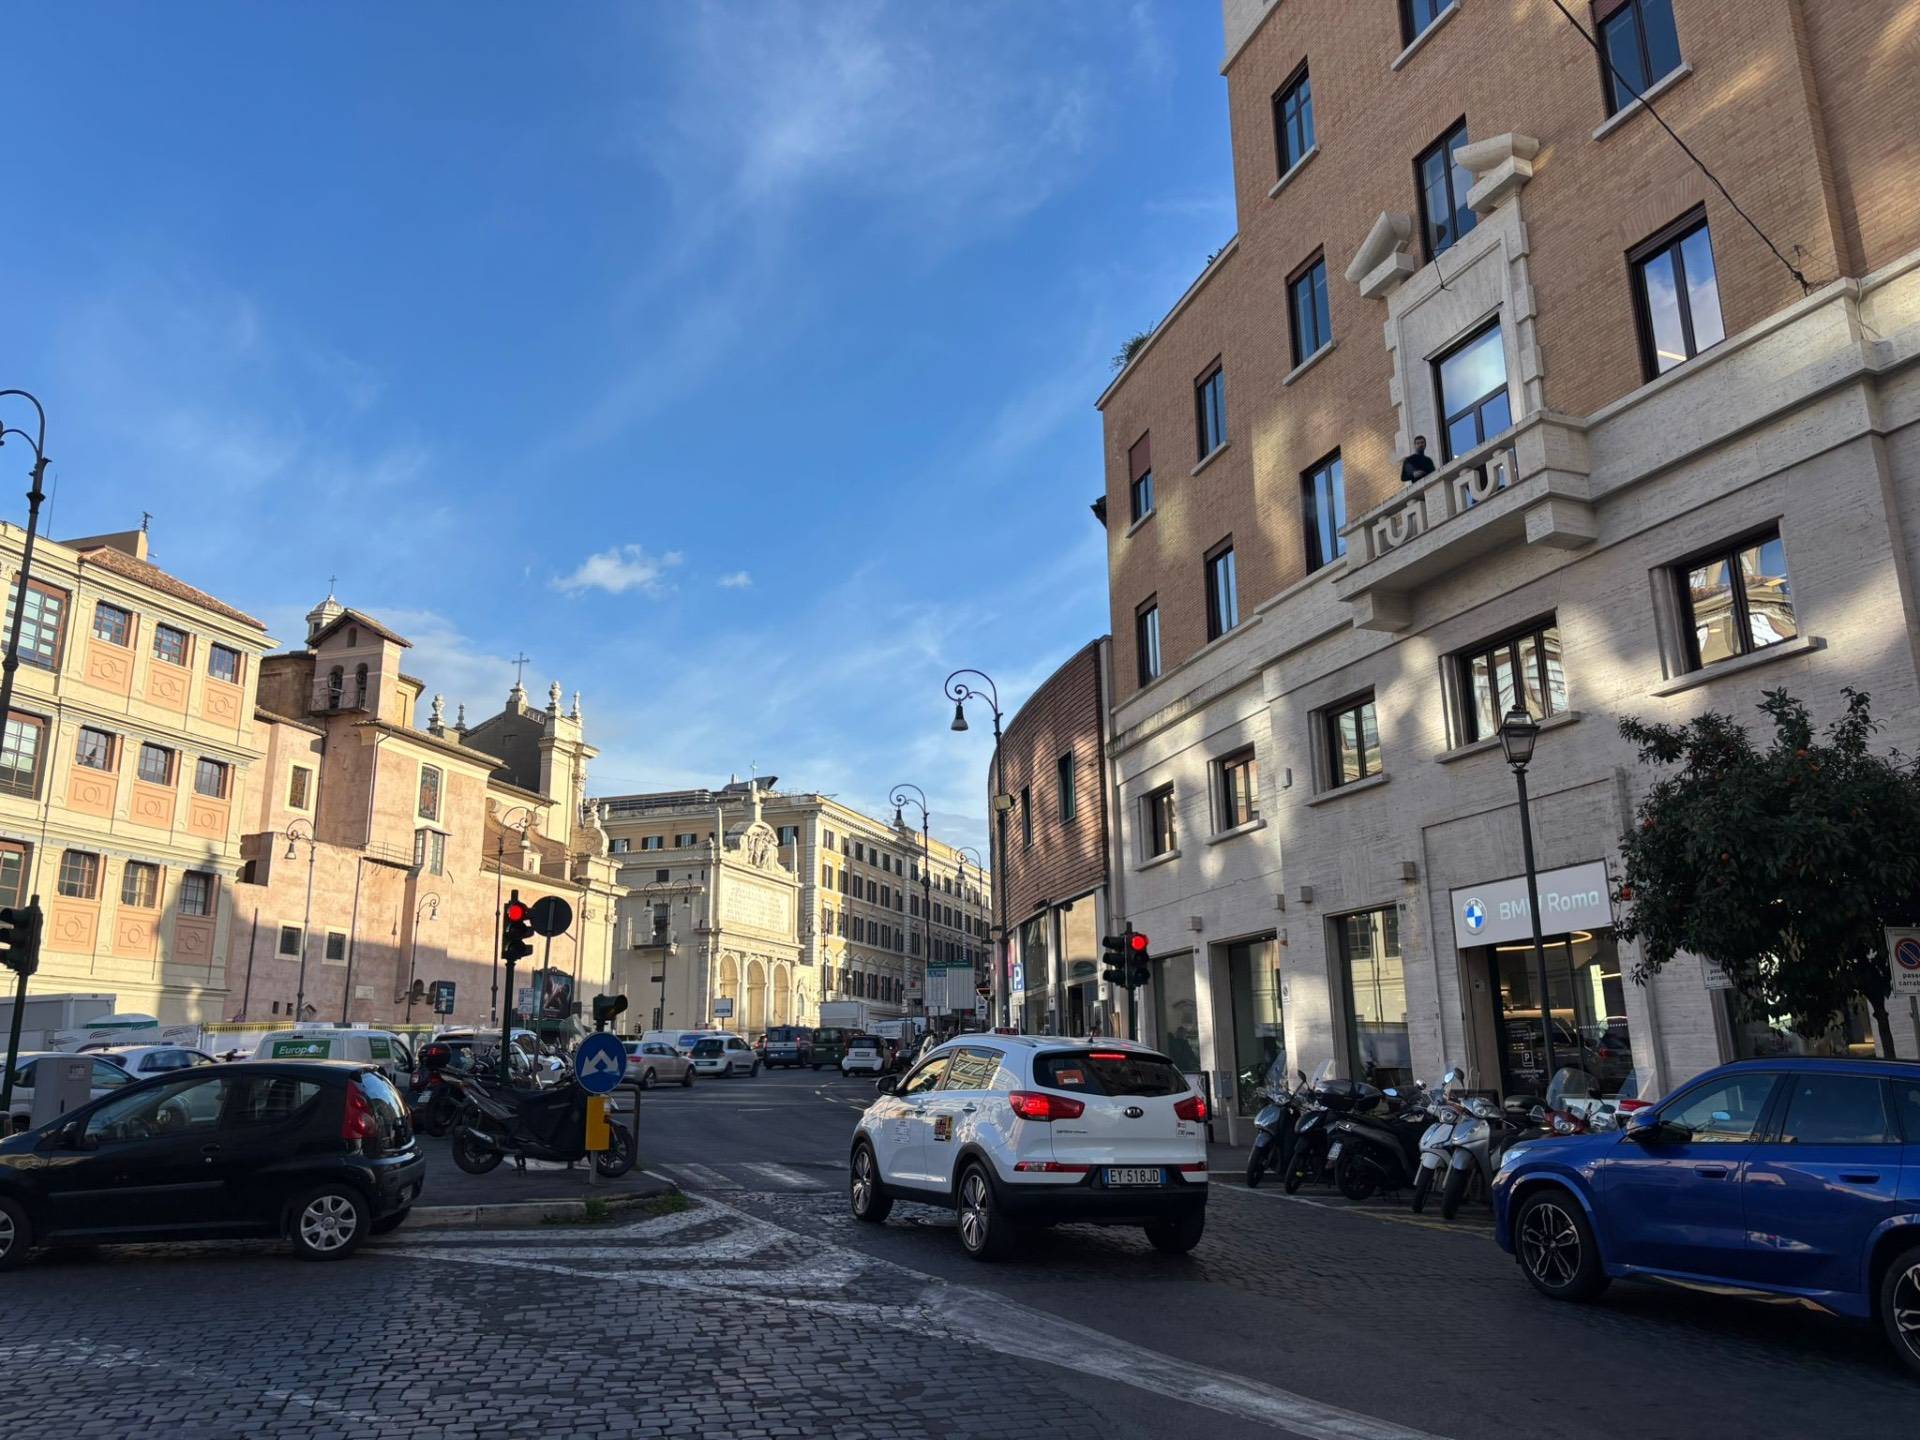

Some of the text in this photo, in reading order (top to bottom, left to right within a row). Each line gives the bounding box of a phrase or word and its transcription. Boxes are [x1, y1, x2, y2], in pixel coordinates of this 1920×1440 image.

[1548, 890, 1600, 912] Roma
[1014, 966, 1022, 989] P
[1110, 1169, 1159, 1183] EY 518JD
